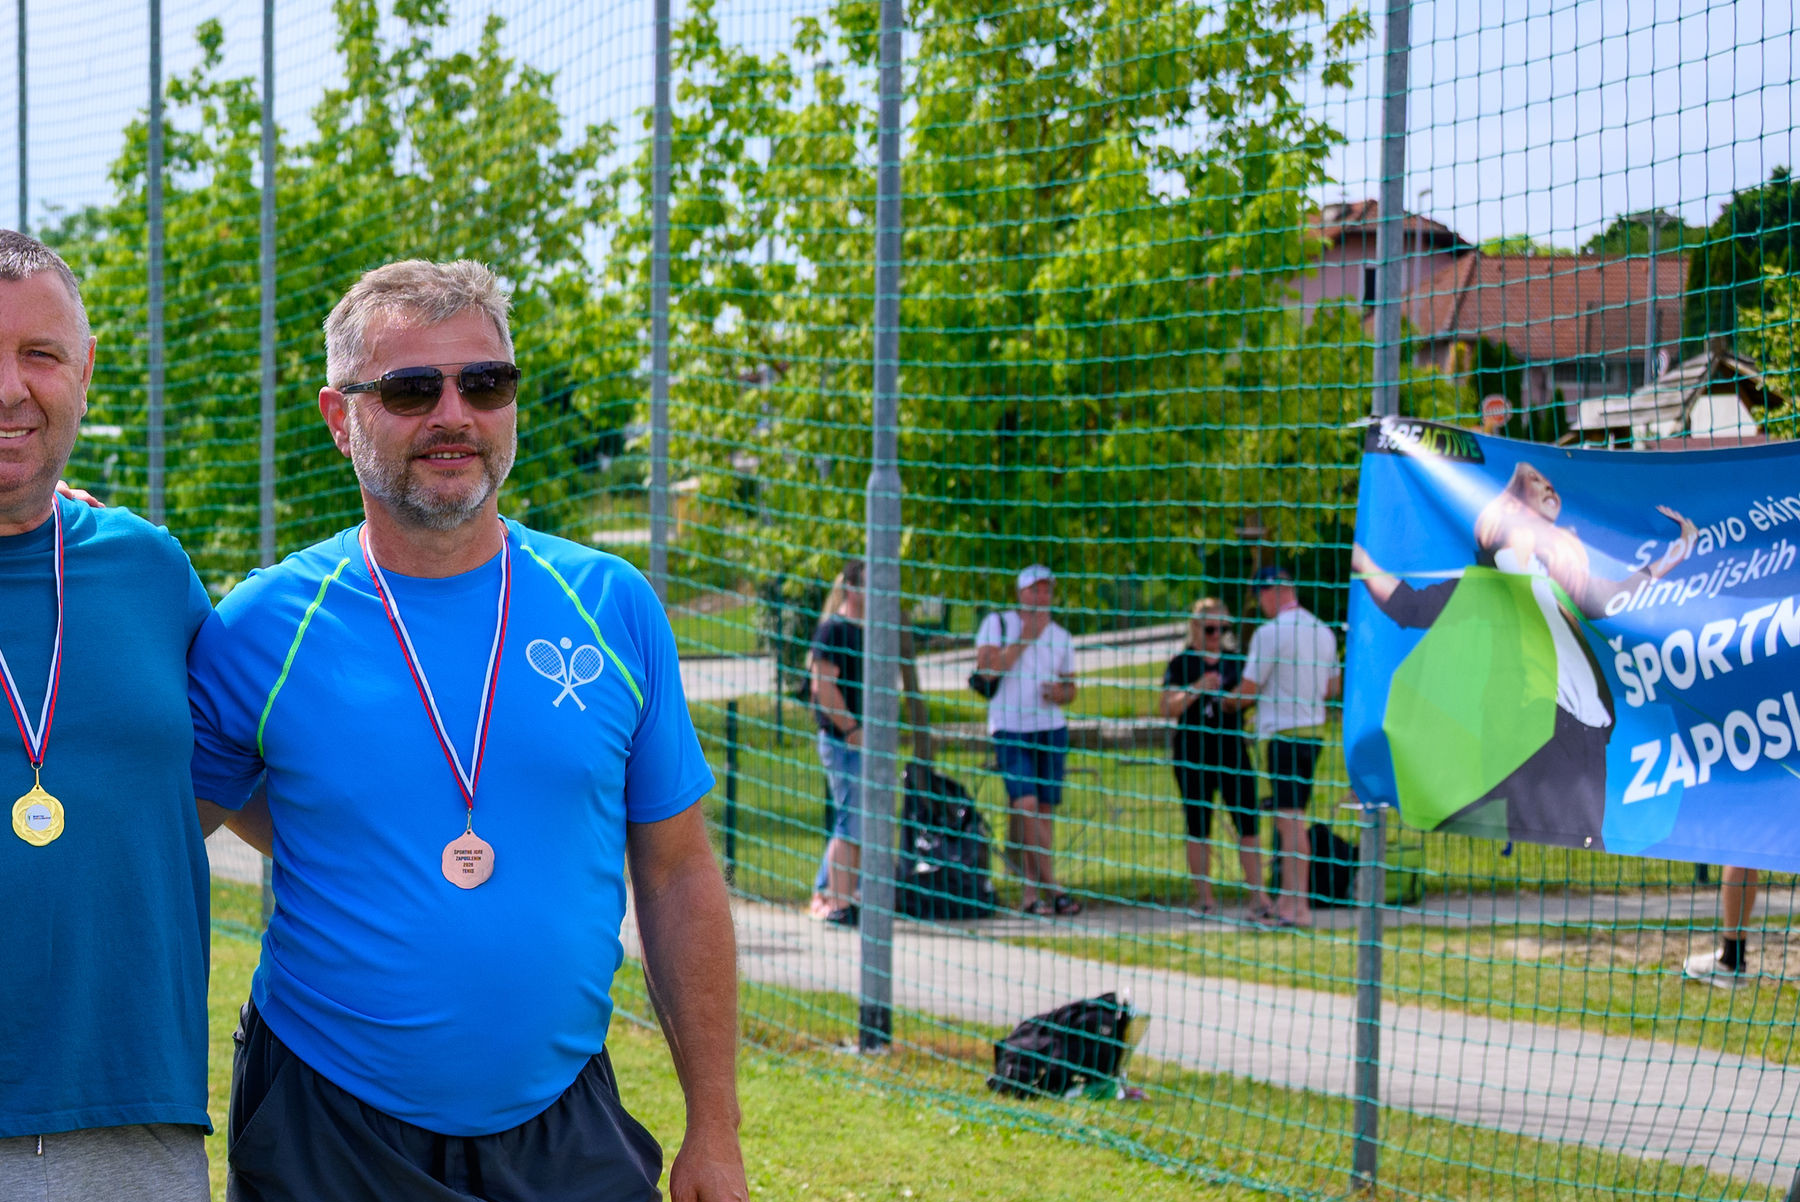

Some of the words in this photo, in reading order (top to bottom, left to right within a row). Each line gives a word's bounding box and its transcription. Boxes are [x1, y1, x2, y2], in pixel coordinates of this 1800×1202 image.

[1656, 516, 1747, 571] pravo
[1748, 492, 1800, 532] ekip
[1604, 538, 1797, 617] olimpijskih
